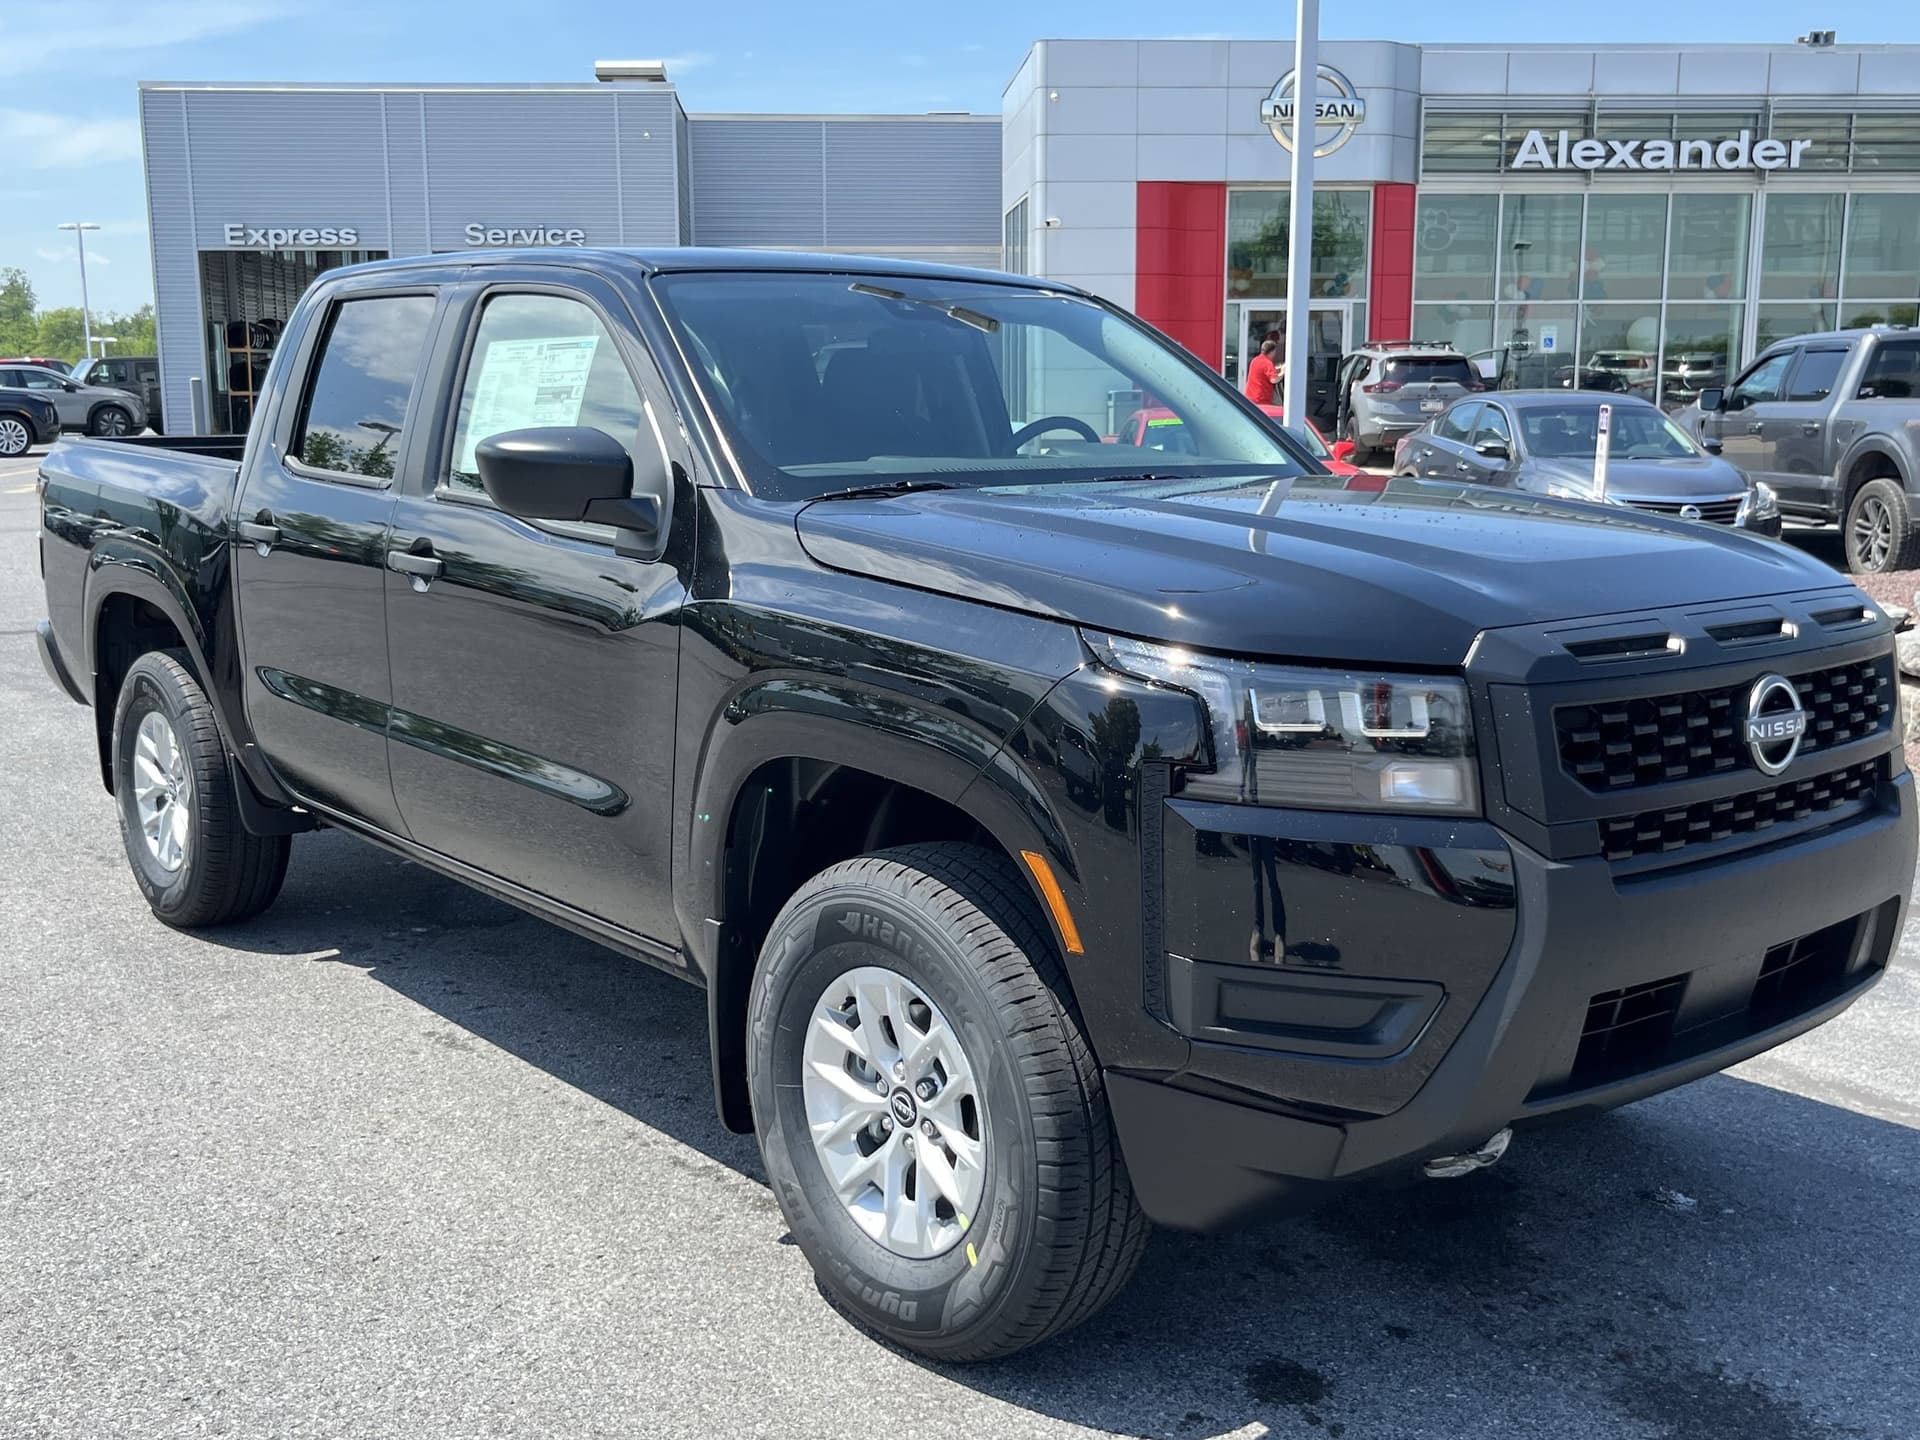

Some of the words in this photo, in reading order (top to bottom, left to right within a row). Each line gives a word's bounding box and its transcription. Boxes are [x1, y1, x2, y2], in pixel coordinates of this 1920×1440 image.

[1272, 103, 1355, 118] NISAN
[1511, 129, 1812, 169] Alexander
[223, 223, 358, 250] Express
[464, 223, 585, 247] Service
[1749, 718, 1803, 739] NISSA
